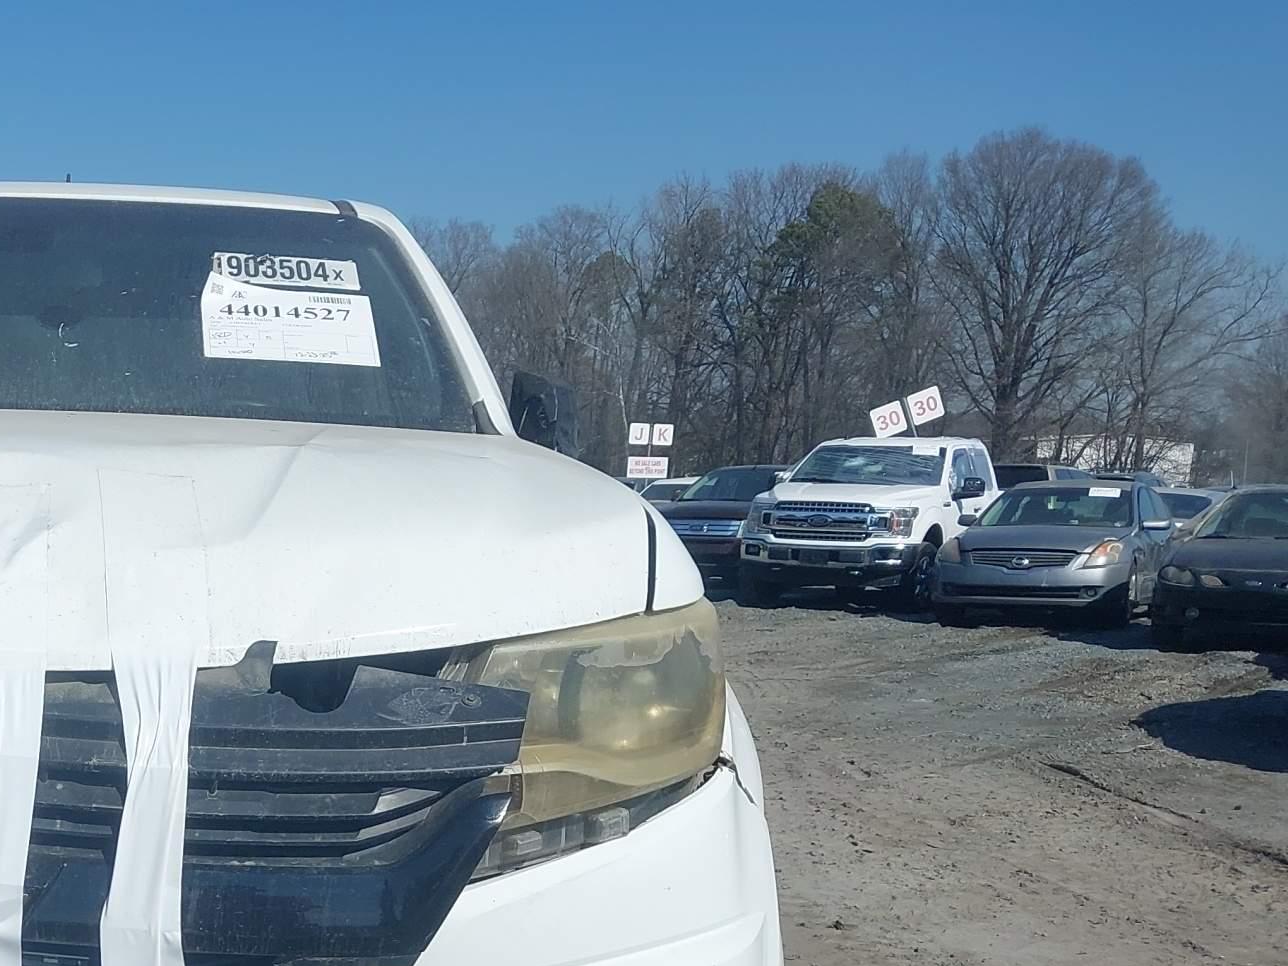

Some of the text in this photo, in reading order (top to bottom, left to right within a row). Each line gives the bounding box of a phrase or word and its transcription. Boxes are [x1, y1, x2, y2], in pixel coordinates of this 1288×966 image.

[219, 303, 351, 321] 44014527
[913, 396, 938, 417] 30
[876, 410, 900, 431] 30
[634, 427, 644, 441] J
[658, 428, 668, 442] K
